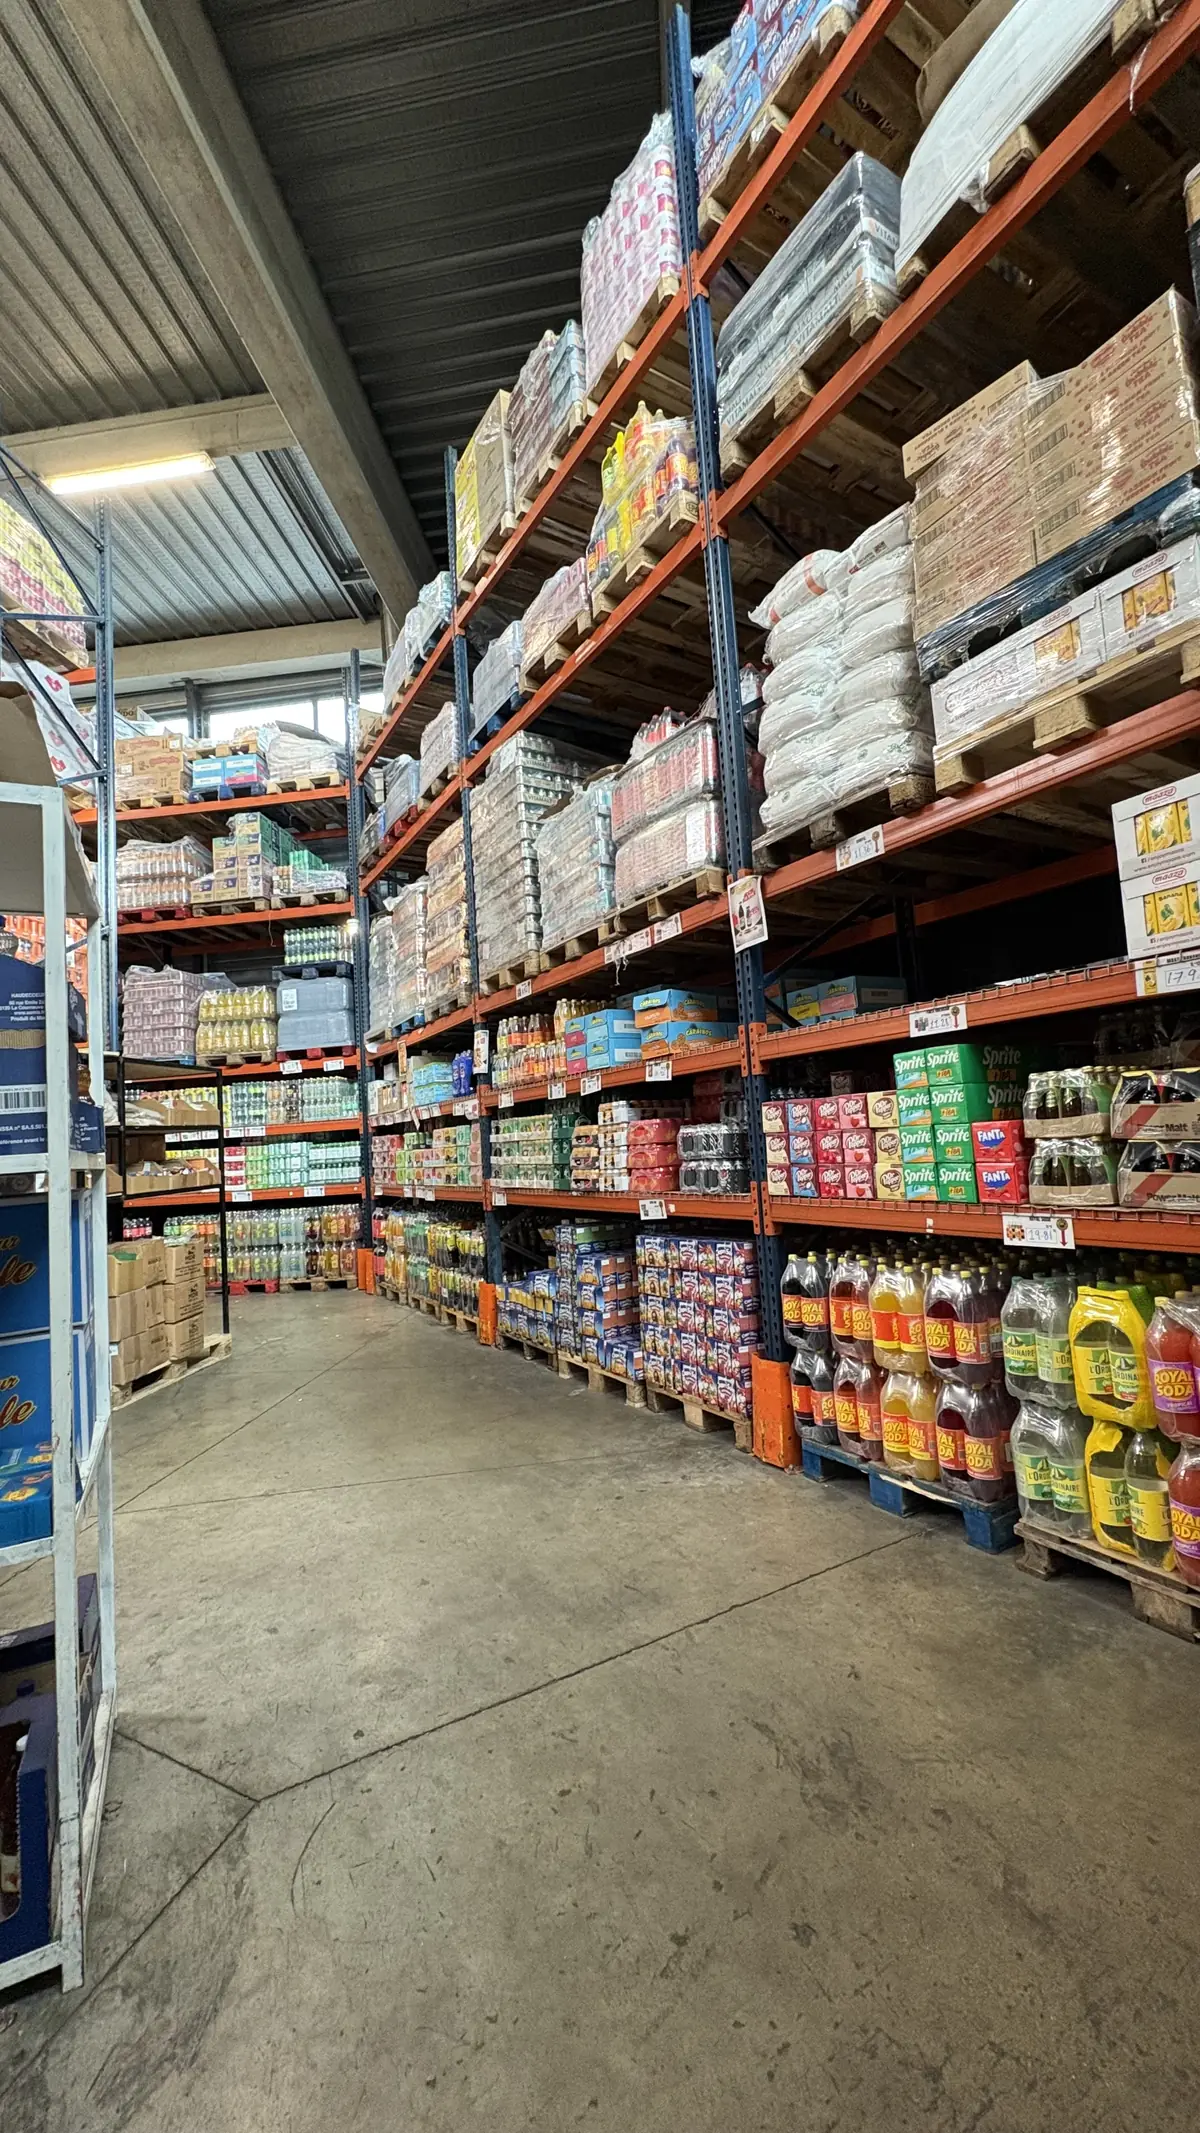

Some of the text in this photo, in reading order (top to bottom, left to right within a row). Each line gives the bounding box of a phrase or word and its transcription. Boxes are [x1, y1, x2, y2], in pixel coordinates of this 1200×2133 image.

[1155, 870, 1184, 883] maaza
[895, 1055, 925, 1073] Sprite
[927, 1050, 959, 1068] Sprite
[983, 1046, 1021, 1065] Sprite
[899, 1093, 929, 1110] Sprite
[932, 1089, 964, 1107] Sprite
[988, 1083, 1025, 1103] Sprite
[901, 1129, 931, 1145] Sprite
[936, 1128, 970, 1145] Sprite
[977, 1129, 1005, 1141] FANTA
[904, 1167, 935, 1184] Sprite
[939, 1167, 972, 1183] Sprite
[982, 1170, 1010, 1183] FANTA
[1155, 1368, 1195, 1386] ROYAL
[1156, 1384, 1195, 1397] SODA
